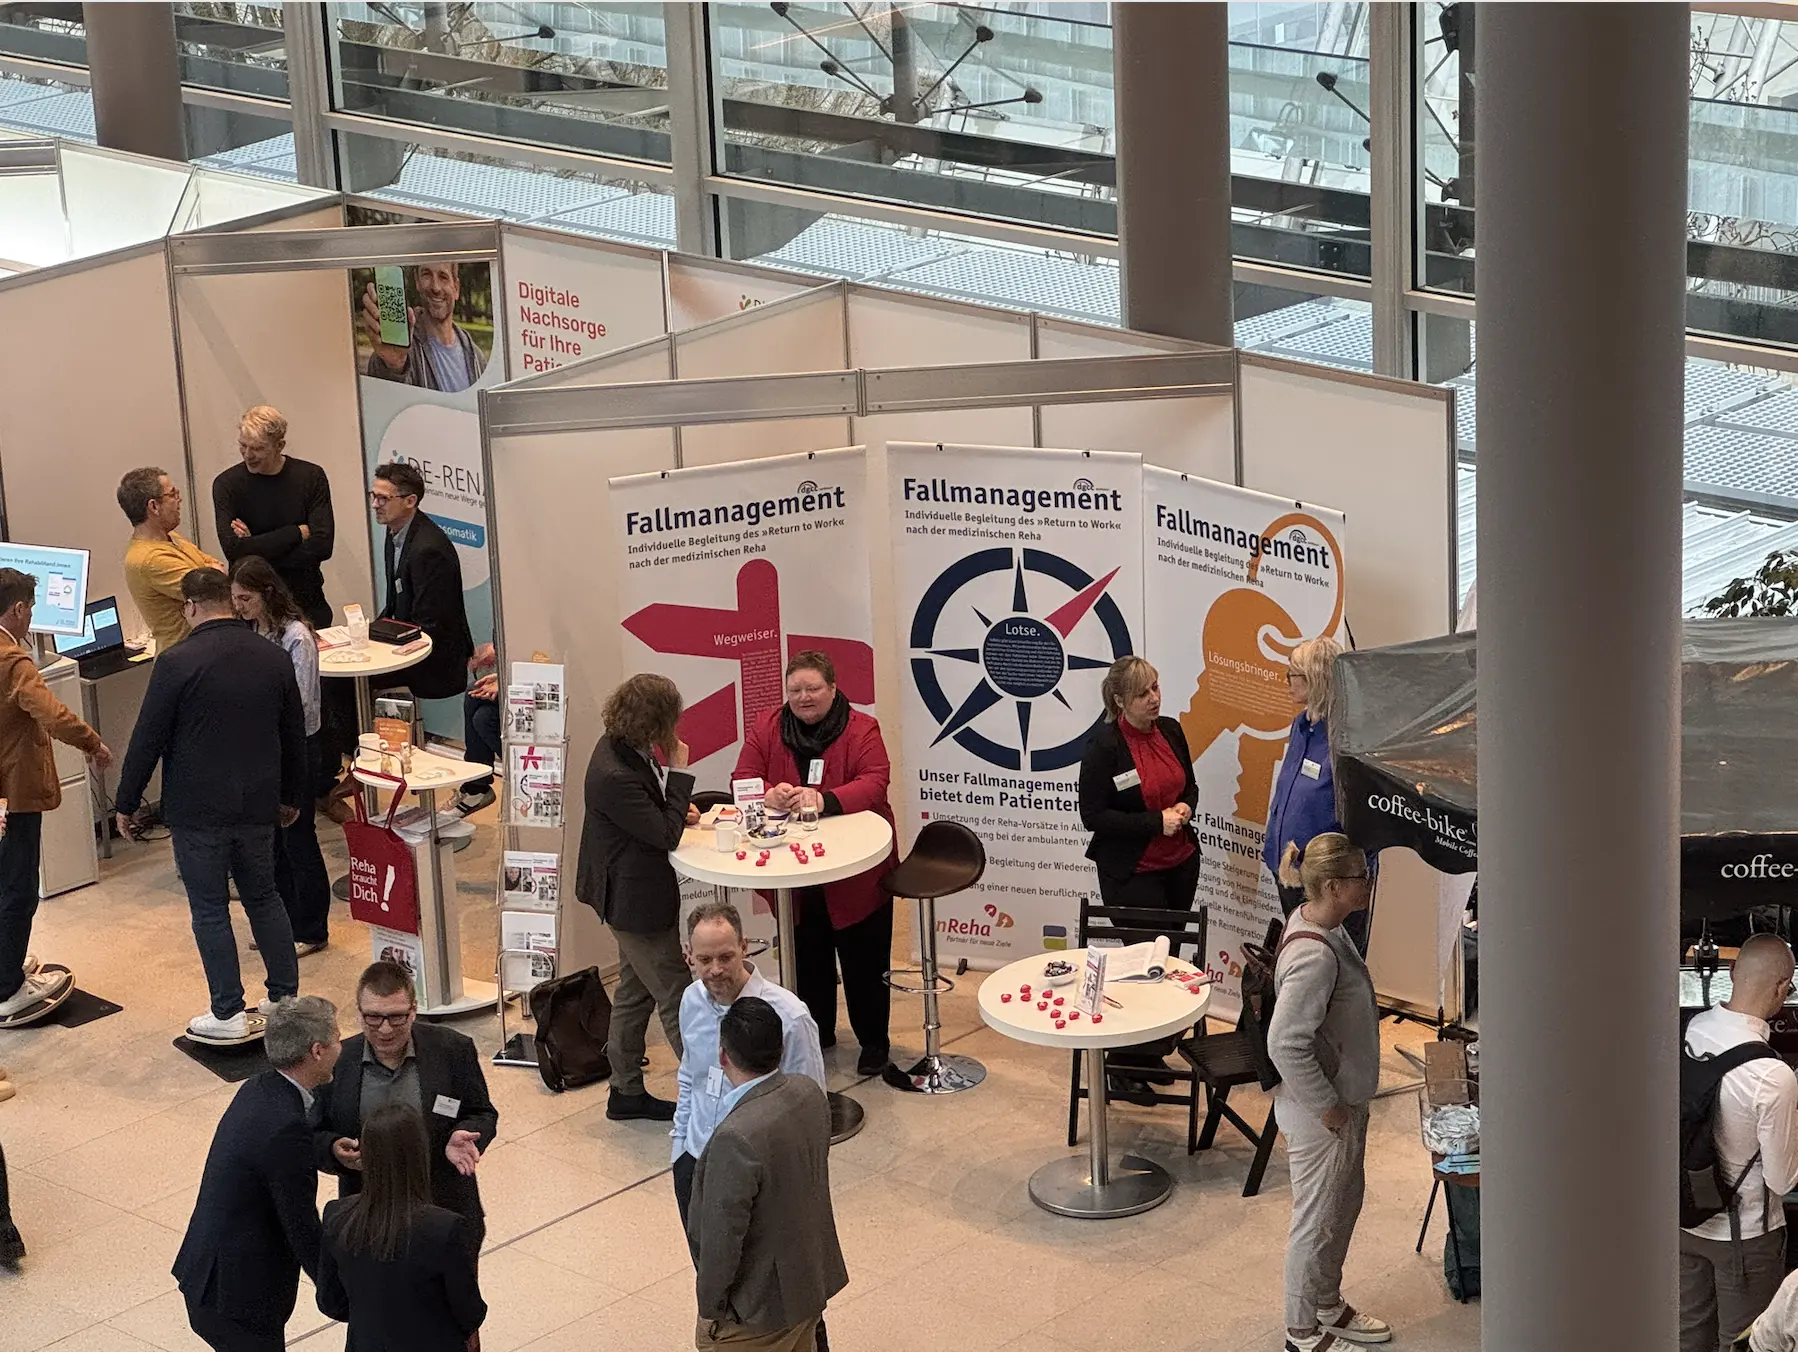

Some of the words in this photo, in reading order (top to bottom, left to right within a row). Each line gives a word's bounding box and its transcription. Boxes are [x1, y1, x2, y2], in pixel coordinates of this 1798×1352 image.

[518, 281, 580, 308] Digitale
[520, 305, 607, 337] Nachsorge
[521, 329, 545, 349] für
[550, 335, 582, 355] Ihre
[904, 478, 1122, 513] Fallmanagement
[626, 486, 846, 535] Fallmanagement
[905, 510, 962, 522] Individuelle
[965, 512, 1016, 527] Begleitung
[1018, 515, 1035, 526] des
[1078, 518, 1089, 529] to
[441, 525, 477, 541] somatik
[628, 538, 686, 554] Individuelle
[688, 532, 741, 548] Begleitung
[743, 528, 760, 539] des
[802, 521, 813, 531] to
[906, 525, 929, 535] nach
[931, 526, 947, 536] der
[949, 527, 1016, 540] medizinischen
[1018, 530, 1042, 541] Reha
[1156, 504, 1330, 569] Fallmanagement
[629, 556, 652, 569] nach
[654, 554, 669, 566] der
[672, 546, 741, 564] medizinischen
[743, 542, 767, 554] Reha
[1157, 537, 1203, 556] Individuelle
[1204, 548, 1245, 570] Begleitung
[1246, 559, 1259, 571] des
[1294, 571, 1303, 581] to
[1158, 553, 1176, 566] nach
[1177, 557, 1190, 568] der
[1191, 562, 1245, 583] medizinischen
[1246, 574, 1264, 588] Reha
[713, 628, 778, 647] Wegweiser.
[1006, 623, 1041, 637] Lotse.
[1208, 650, 1282, 682] Lösungsbringer.
[919, 769, 960, 784] Unser
[963, 772, 1080, 793] Fallmanagement
[920, 788, 963, 803] bietet
[965, 792, 995, 806] dem
[932, 812, 980, 825] Umsetzung
[981, 815, 995, 825] der
[997, 817, 1059, 830] Reha-Vorsätze
[1060, 822, 1070, 832] in
[1368, 794, 1467, 842] coffee-bike
[996, 831, 1010, 841] bei
[1011, 834, 1025, 842] der
[1027, 836, 1079, 846] ambulanten
[1205, 813, 1266, 844] Fallmanage
[1434, 835, 1458, 851] Mobile
[350, 857, 377, 875] Reha
[989, 857, 1036, 871] Begleitung
[1037, 861, 1052, 869] der
[1054, 862, 1097, 873] Wiederein
[1222, 861, 1260, 883] Steigerung
[1261, 874, 1273, 885] des
[351, 871, 378, 886] braucht
[1222, 879, 1235, 888] von
[352, 884, 379, 903] Dich
[987, 883, 1009, 892] einer
[1011, 886, 1037, 895] neuen
[1039, 886, 1088, 899] beruflichen
[1090, 890, 1101, 900] Pe
[1215, 888, 1229, 898] und
[1230, 892, 1241, 901] die
[1242, 895, 1283, 914] Eingliederu
[1223, 905, 1270, 925] Heranführun
[936, 918, 991, 937] nReha
[946, 935, 968, 944] Partner
[995, 940, 1012, 948] Ziele
